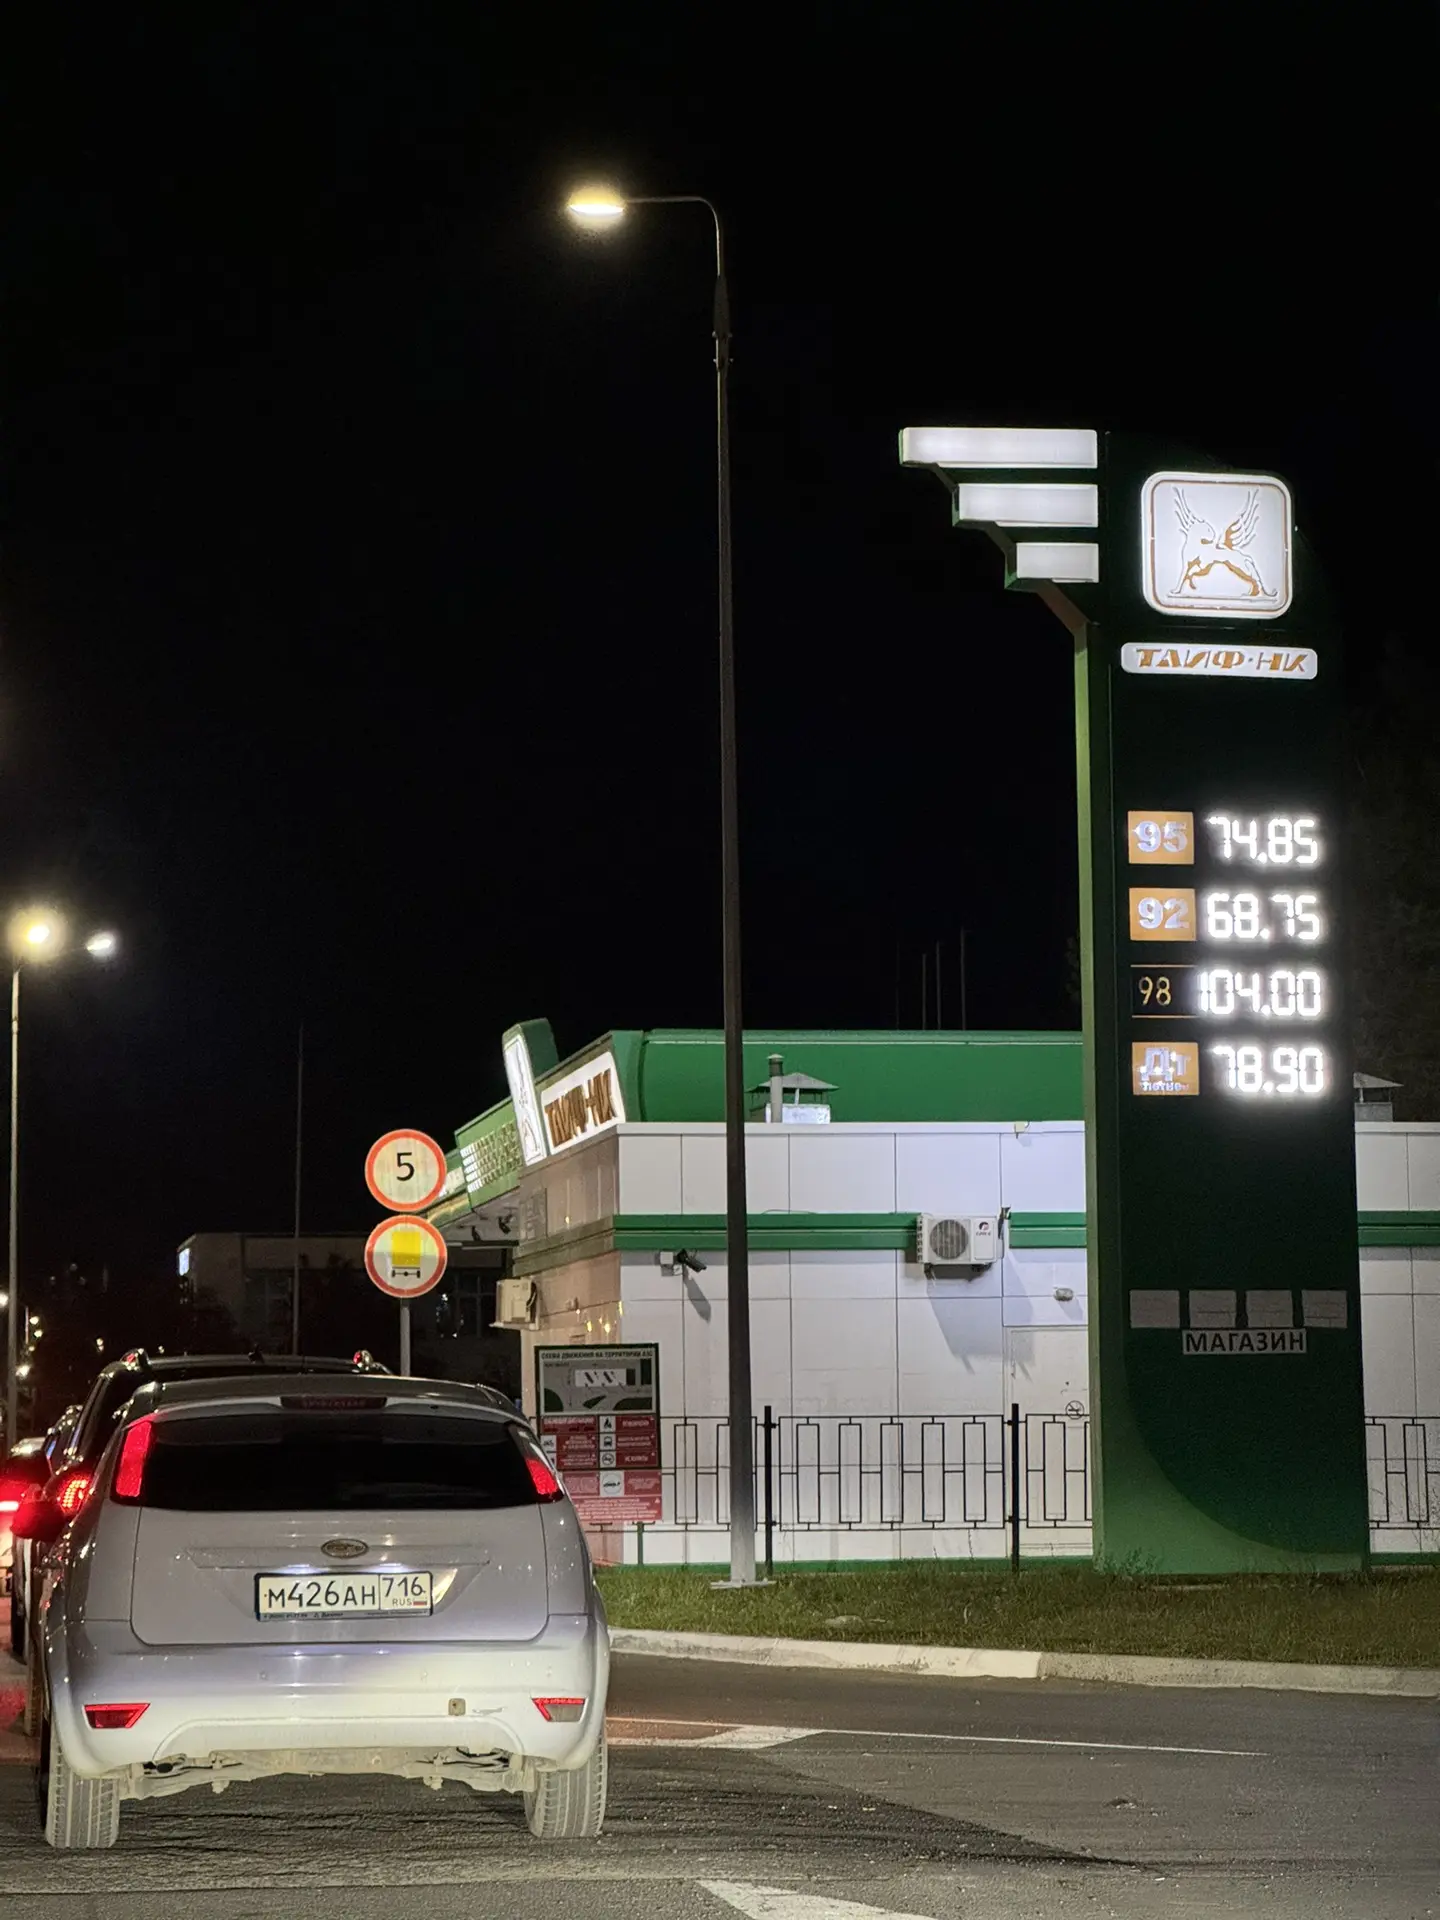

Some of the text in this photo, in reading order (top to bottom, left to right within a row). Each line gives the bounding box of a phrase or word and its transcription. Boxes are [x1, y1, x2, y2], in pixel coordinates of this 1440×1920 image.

[1133, 816, 1319, 864] 95 74.85
[1138, 893, 1320, 941] 92 68.75
[1138, 968, 1321, 1017] 98 104.00
[1210, 1045, 1324, 1094] 78.90
[396, 1151, 415, 1182] 5
[1186, 1331, 1304, 1352] МАГАЗИН
[382, 1576, 424, 1598] 716
[392, 1599, 412, 1607] RUS
